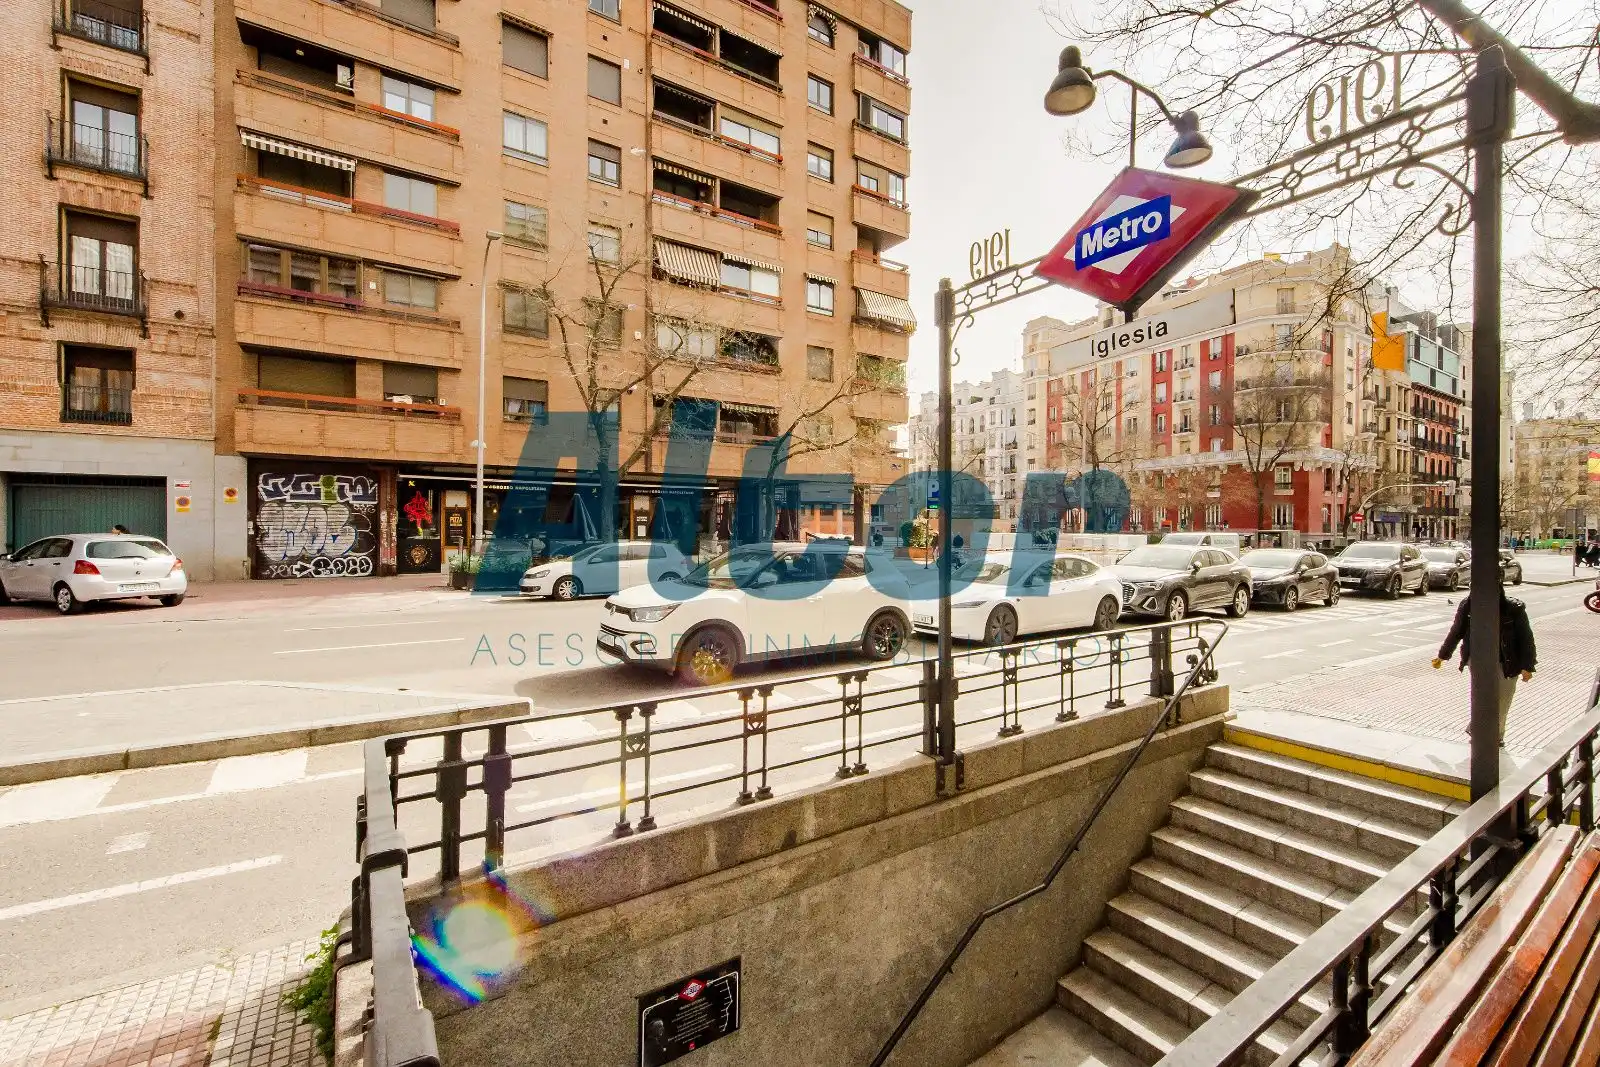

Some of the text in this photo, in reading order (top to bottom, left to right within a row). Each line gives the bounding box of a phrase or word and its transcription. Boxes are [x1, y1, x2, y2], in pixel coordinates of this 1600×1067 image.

[1082, 211, 1162, 259] Metro
[1091, 320, 1168, 358] Iglesia
[928, 480, 939, 497] P
